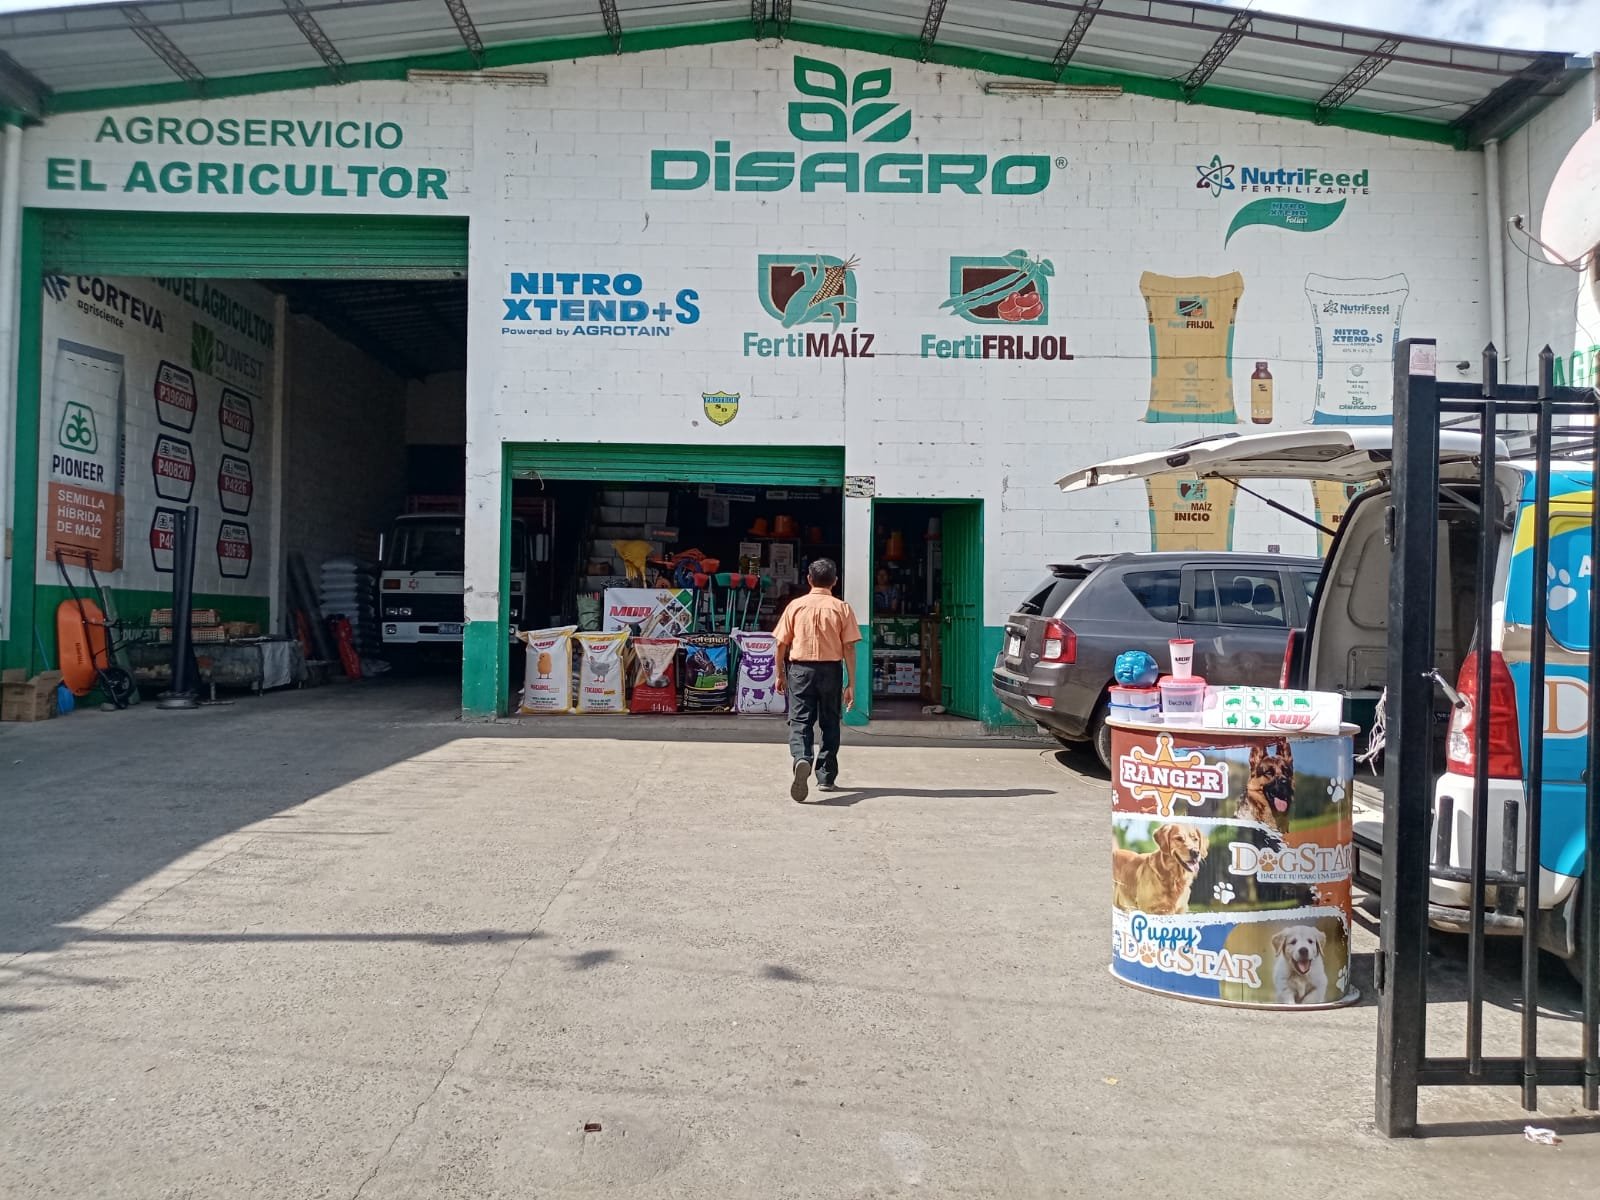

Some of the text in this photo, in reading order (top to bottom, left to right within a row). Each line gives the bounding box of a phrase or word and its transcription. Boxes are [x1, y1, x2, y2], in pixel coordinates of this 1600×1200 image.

[95, 116, 403, 150] AGROSERVICIO
[46, 157, 448, 200] EL AGRICULTOR
[1241, 167, 1369, 187] NutriFeed
[1241, 185, 1369, 195] FERTILIZANTE
[510, 272, 643, 295] NITRO
[76, 275, 164, 333] CORTEVA
[77, 299, 125, 328] agriscience
[201, 283, 275, 350] AGRICULTOR
[502, 288, 700, 325] XTEND+S
[1340, 303, 1390, 313] NutriFeed
[501, 325, 672, 337] Powered by AGROTAIN
[743, 328, 875, 358] FertiMAÍZ
[1334, 328, 1369, 336] NITRO
[921, 334, 1074, 361] FertiFRIJOL
[53, 454, 104, 483] PIONEER
[58, 489, 106, 510] SEMILLA
[56, 520, 73, 534] DE
[57, 504, 103, 525] HÍBRIDA
[1174, 512, 1210, 522] INICIO
[1268, 713, 1311, 726] MOR
[1122, 761, 1223, 792] RANGER
[1131, 914, 1200, 954] Puppy
